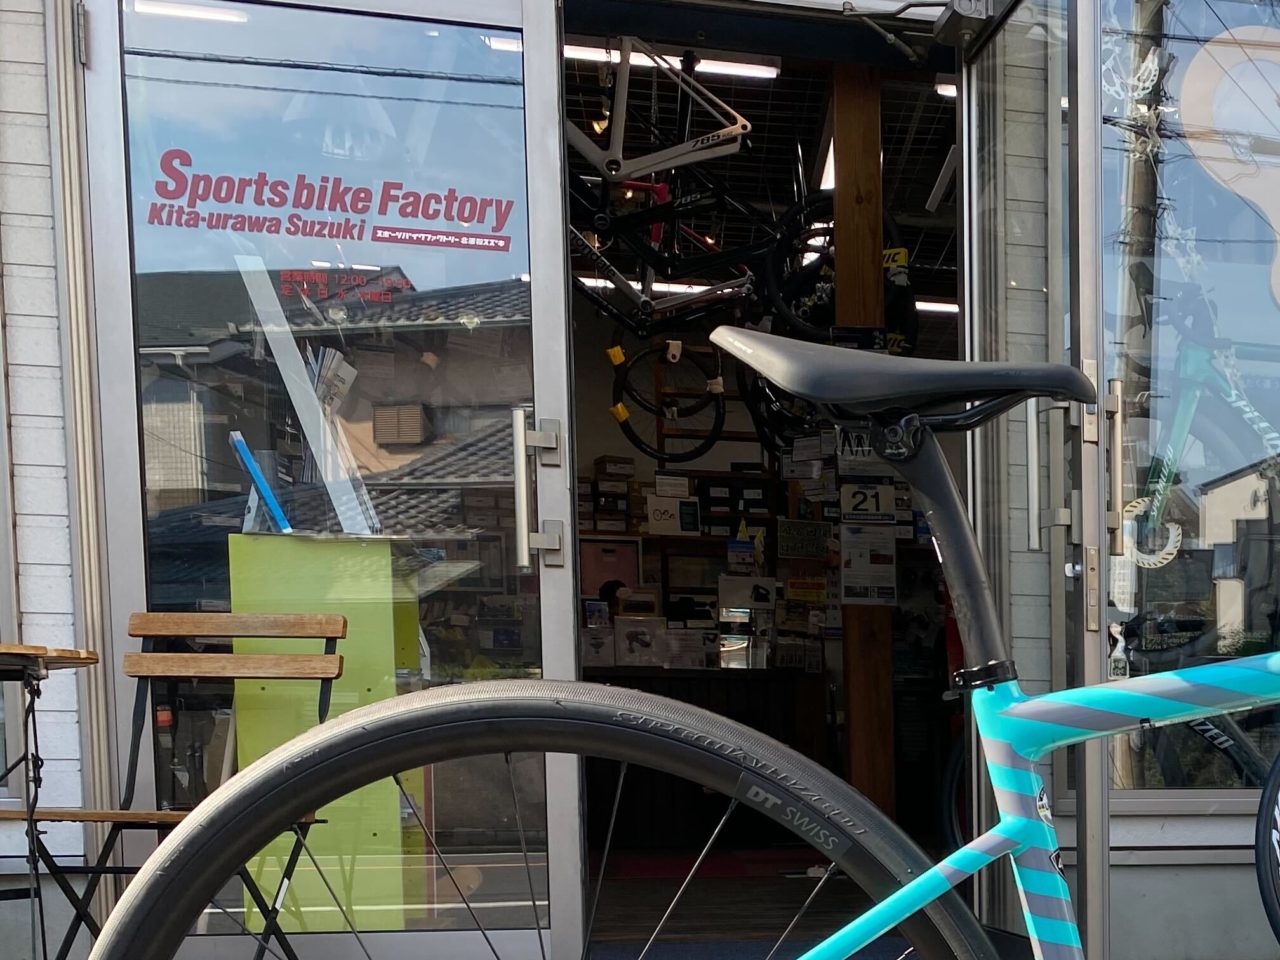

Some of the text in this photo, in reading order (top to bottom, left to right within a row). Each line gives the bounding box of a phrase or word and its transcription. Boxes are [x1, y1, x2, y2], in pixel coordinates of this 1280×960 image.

[147, 202, 366, 241] Kita-urawa Suzuki
[378, 181, 514, 233] Factory
[851, 490, 880, 512] 21
[746, 785, 840, 850] DT SWISS
